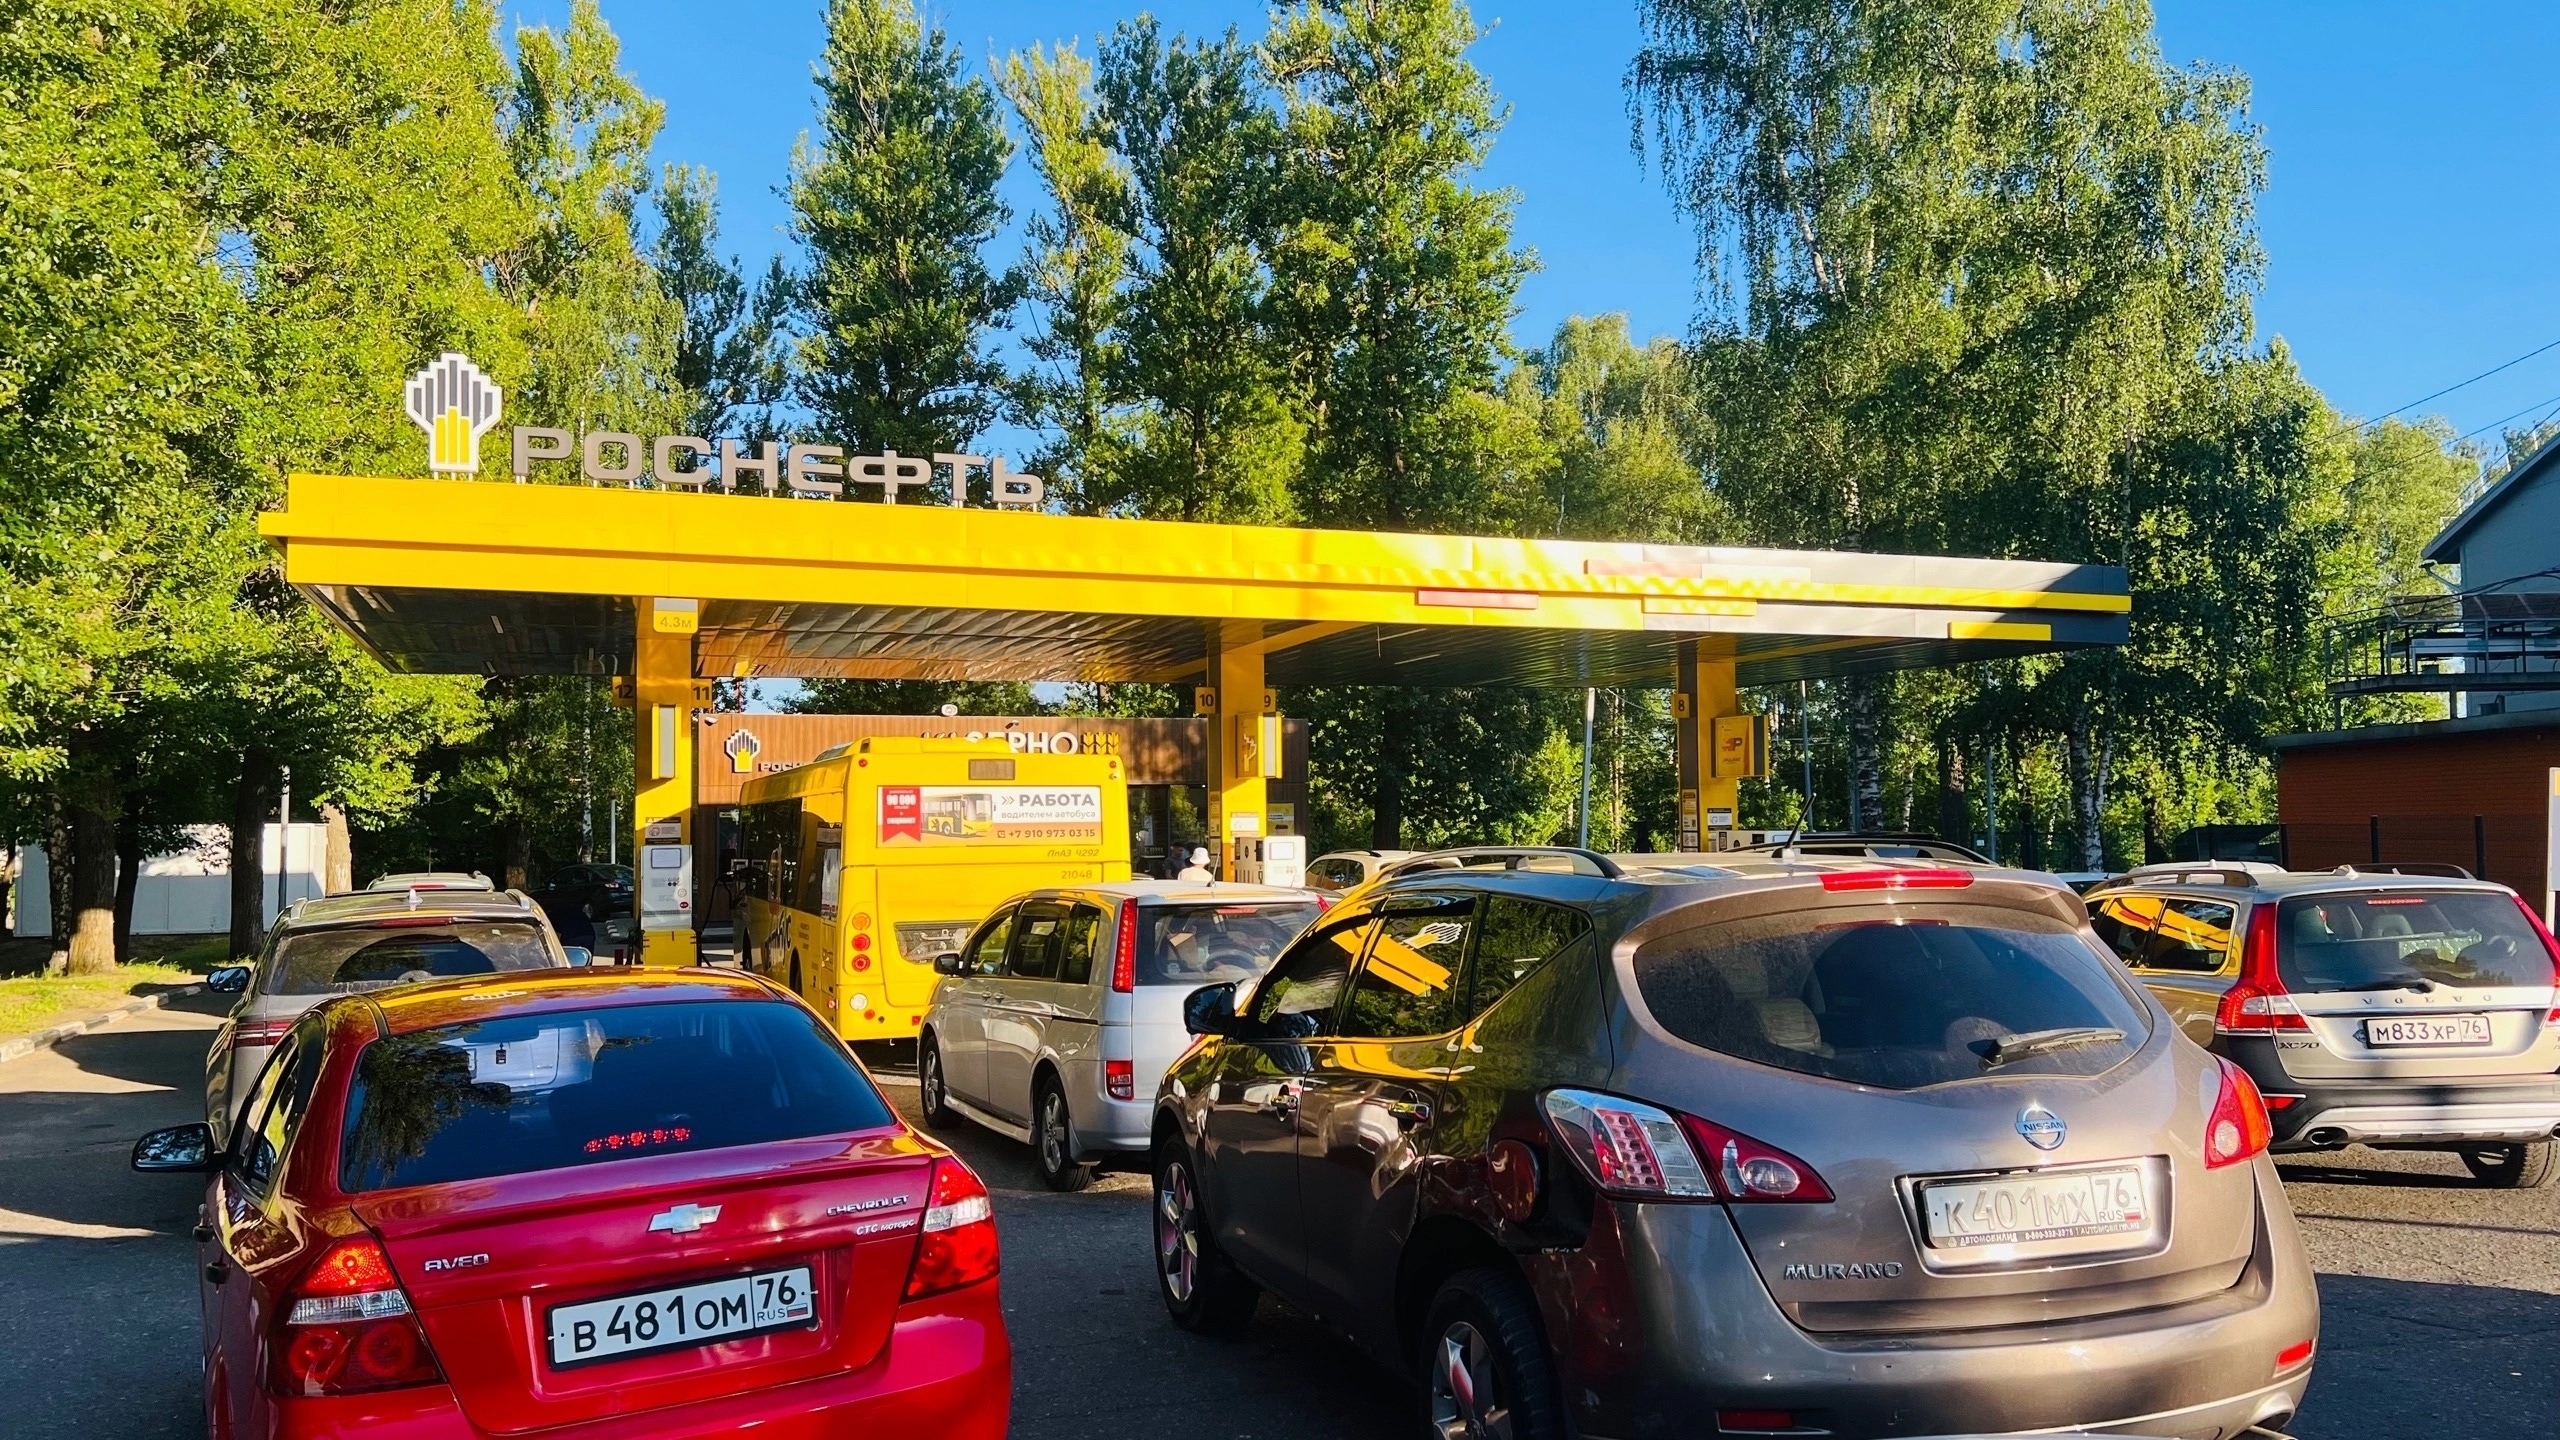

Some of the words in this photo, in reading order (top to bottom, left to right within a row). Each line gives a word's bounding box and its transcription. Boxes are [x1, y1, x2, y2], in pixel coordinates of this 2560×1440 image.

[511, 426, 1045, 503] РОСНЕФТЬ
[614, 685, 634, 699] 12
[692, 686, 710, 701] 11
[1198, 693, 1215, 707] 10
[1263, 694, 1271, 708] 9
[1678, 699, 1685, 712] 8
[1019, 793, 1095, 807] РАБОТА
[1001, 811, 1053, 819] водителем
[1054, 810, 1096, 819] автобуса
[1008, 830, 1021, 838] +7
[1024, 830, 1043, 838] 910
[1069, 829, 1083, 837] 03
[1085, 829, 1096, 837] 15
[1075, 849, 1100, 857] 4292
[1061, 870, 1093, 879] 21048
[2461, 1021, 2482, 1034] 76
[2023, 1121, 2065, 1131] NISSAN
[2095, 1177, 2131, 1210] 76
[826, 1195, 910, 1217] CHEVROLET
[2098, 1210, 2123, 1221] RUS
[424, 1252, 490, 1273] AVEO
[1783, 1262, 1903, 1281] MURANO
[755, 1274, 797, 1308] 76
[757, 1306, 786, 1322] RUS
